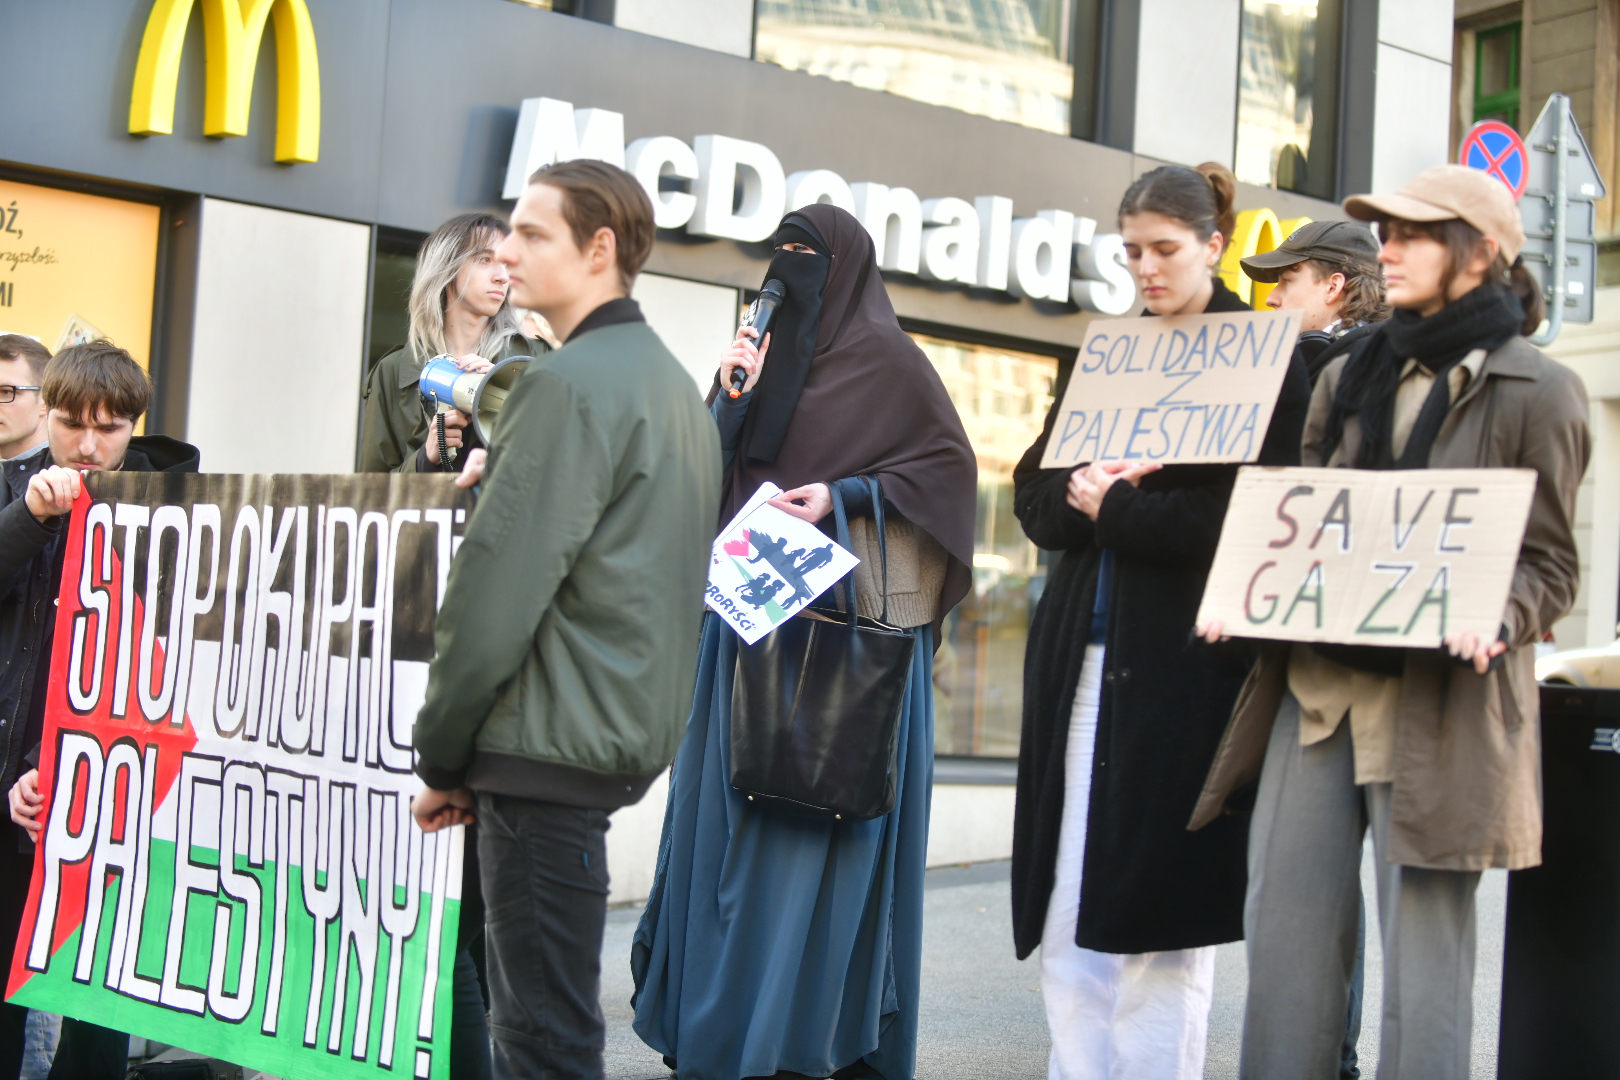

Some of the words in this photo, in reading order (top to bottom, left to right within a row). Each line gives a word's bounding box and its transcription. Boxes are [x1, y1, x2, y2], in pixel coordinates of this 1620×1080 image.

[502, 97, 1136, 316] McDonald's
[1082, 316, 1291, 376] SOLIDARNI
[1155, 370, 1203, 407] Z
[1268, 485, 1480, 553] SAVE
[66, 502, 222, 728] STOP
[1245, 560, 1451, 637] GAZA
[25, 728, 452, 1080] PALESTYNY!
